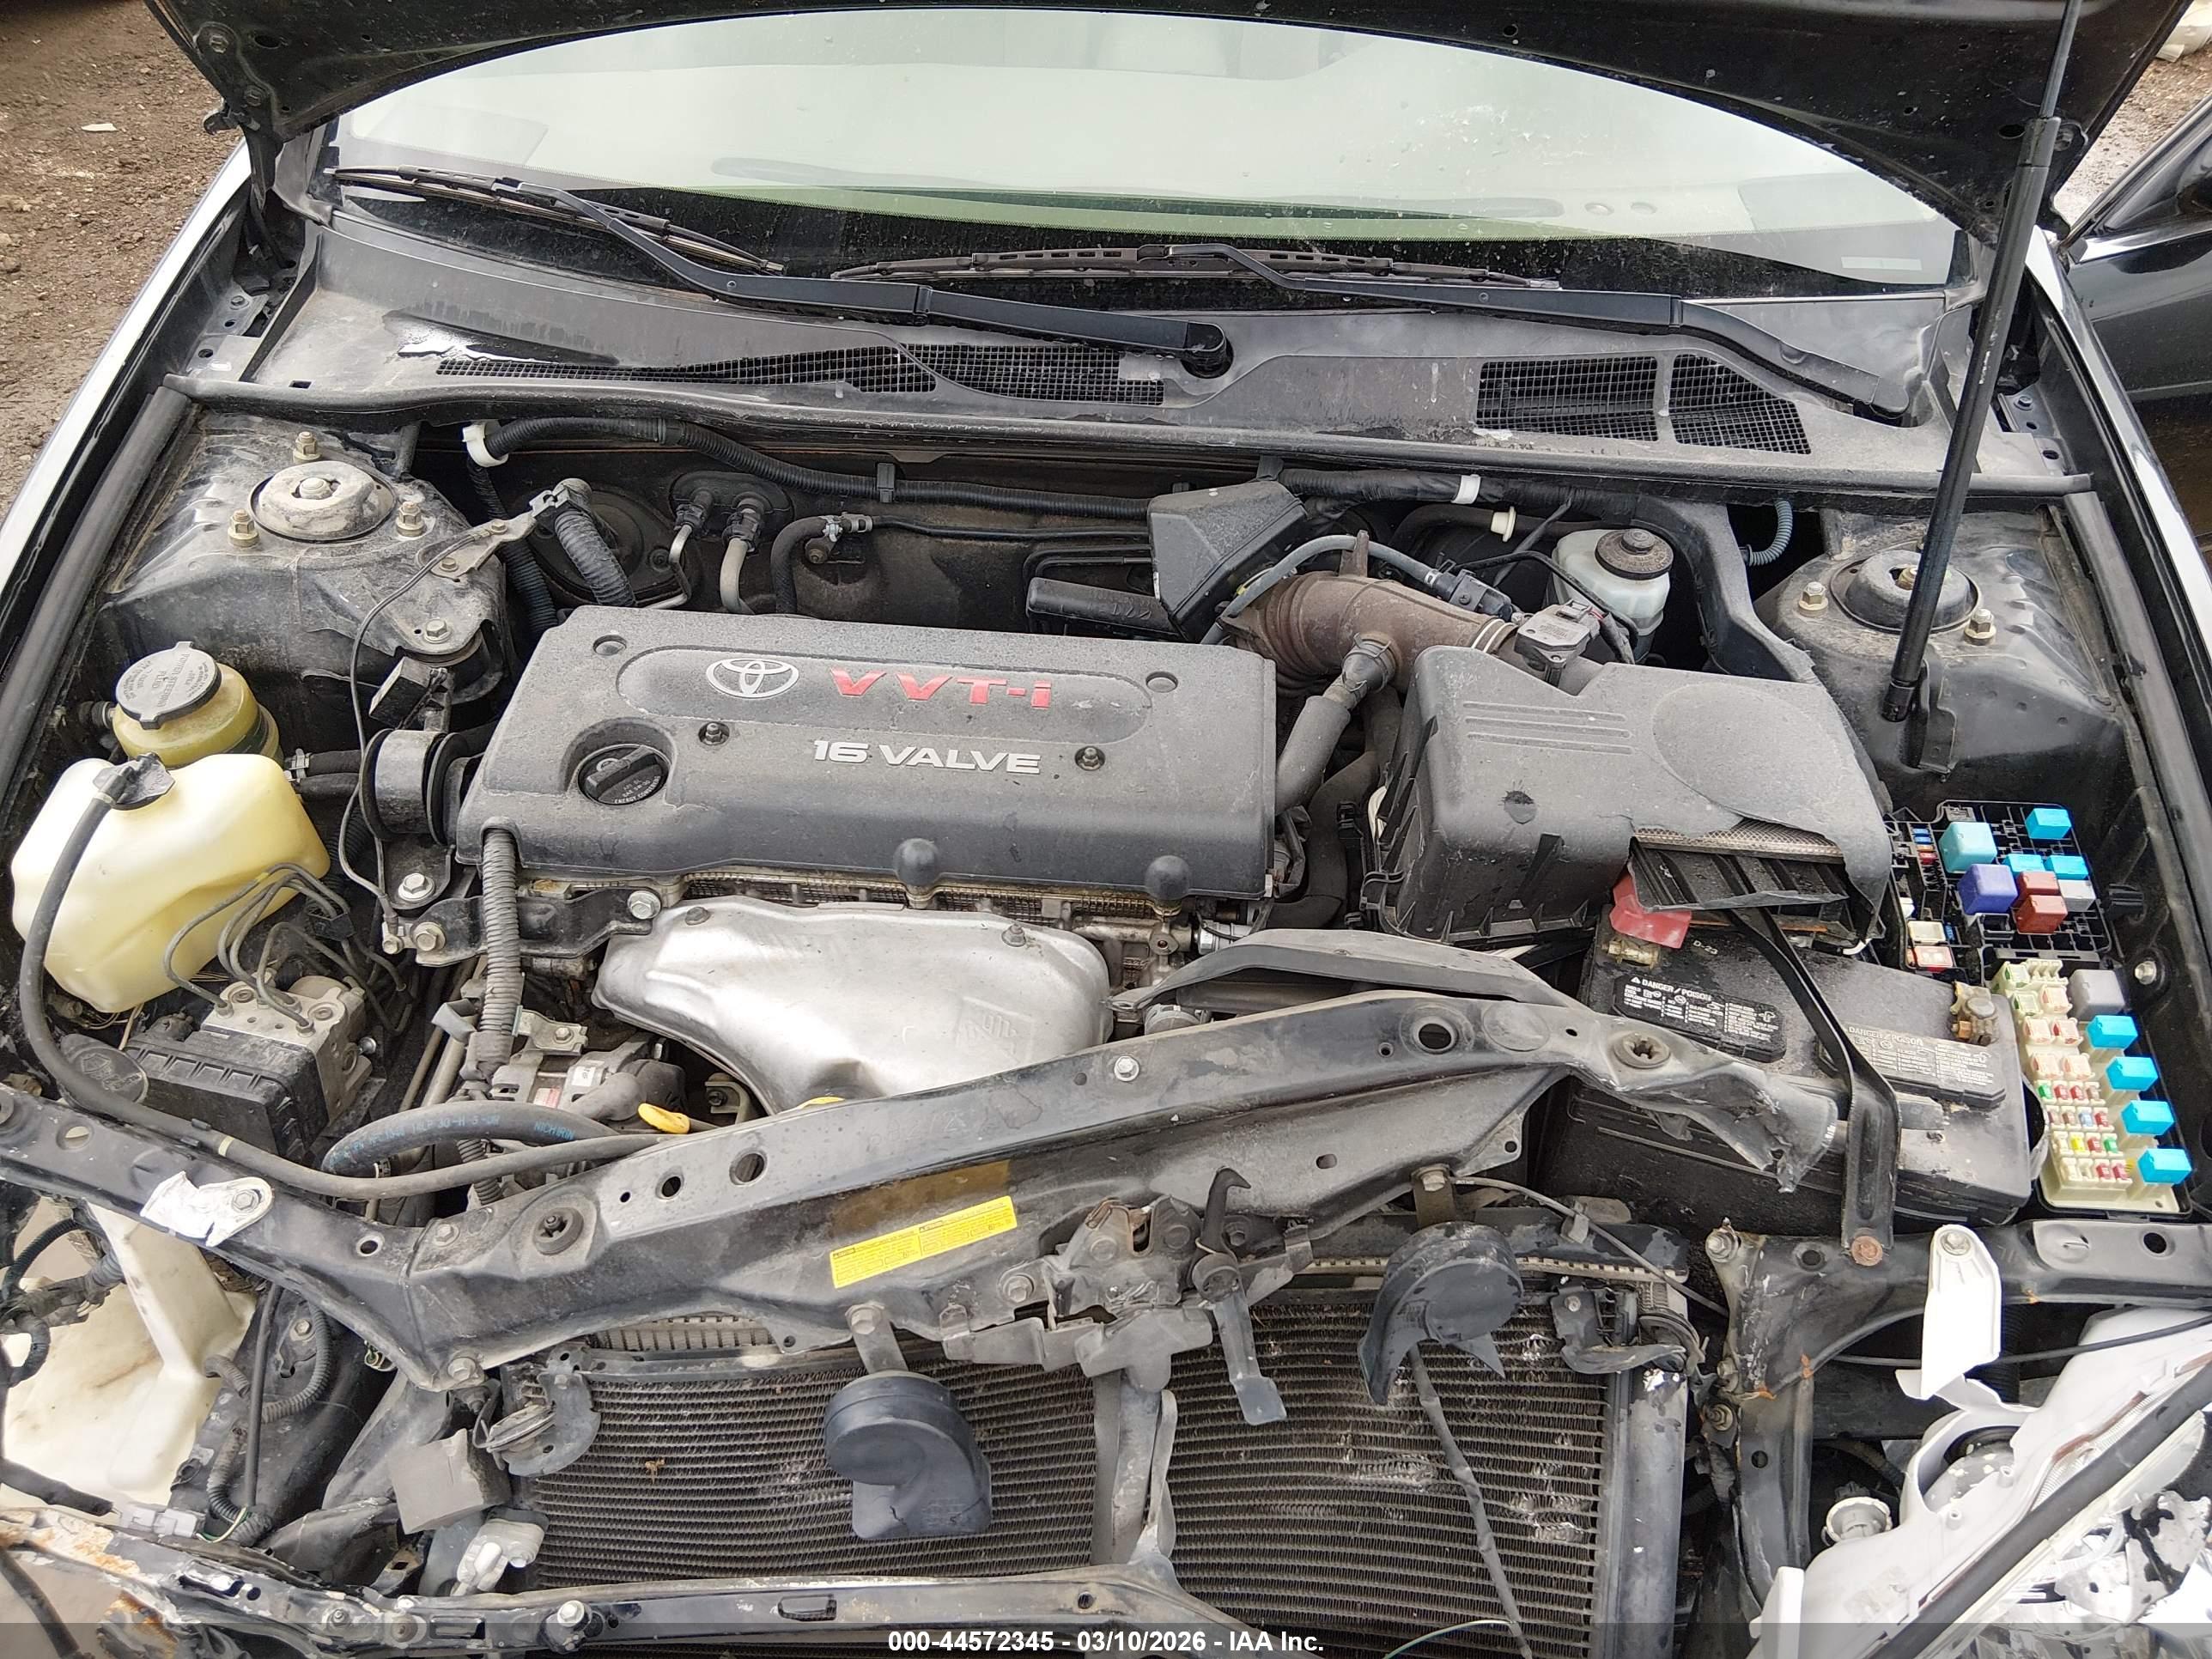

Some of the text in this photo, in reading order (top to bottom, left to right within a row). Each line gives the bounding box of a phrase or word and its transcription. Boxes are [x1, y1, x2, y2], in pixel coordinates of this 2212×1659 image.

[830, 667, 1052, 709] VVT-i
[813, 740, 1042, 775] 16 VALVE
[1692, 940, 1718, 955] D-23
[1641, 979, 1674, 994] DANGER
[1681, 988, 1712, 1002] POISON
[532, 1120, 576, 1142] NICHIRIN
